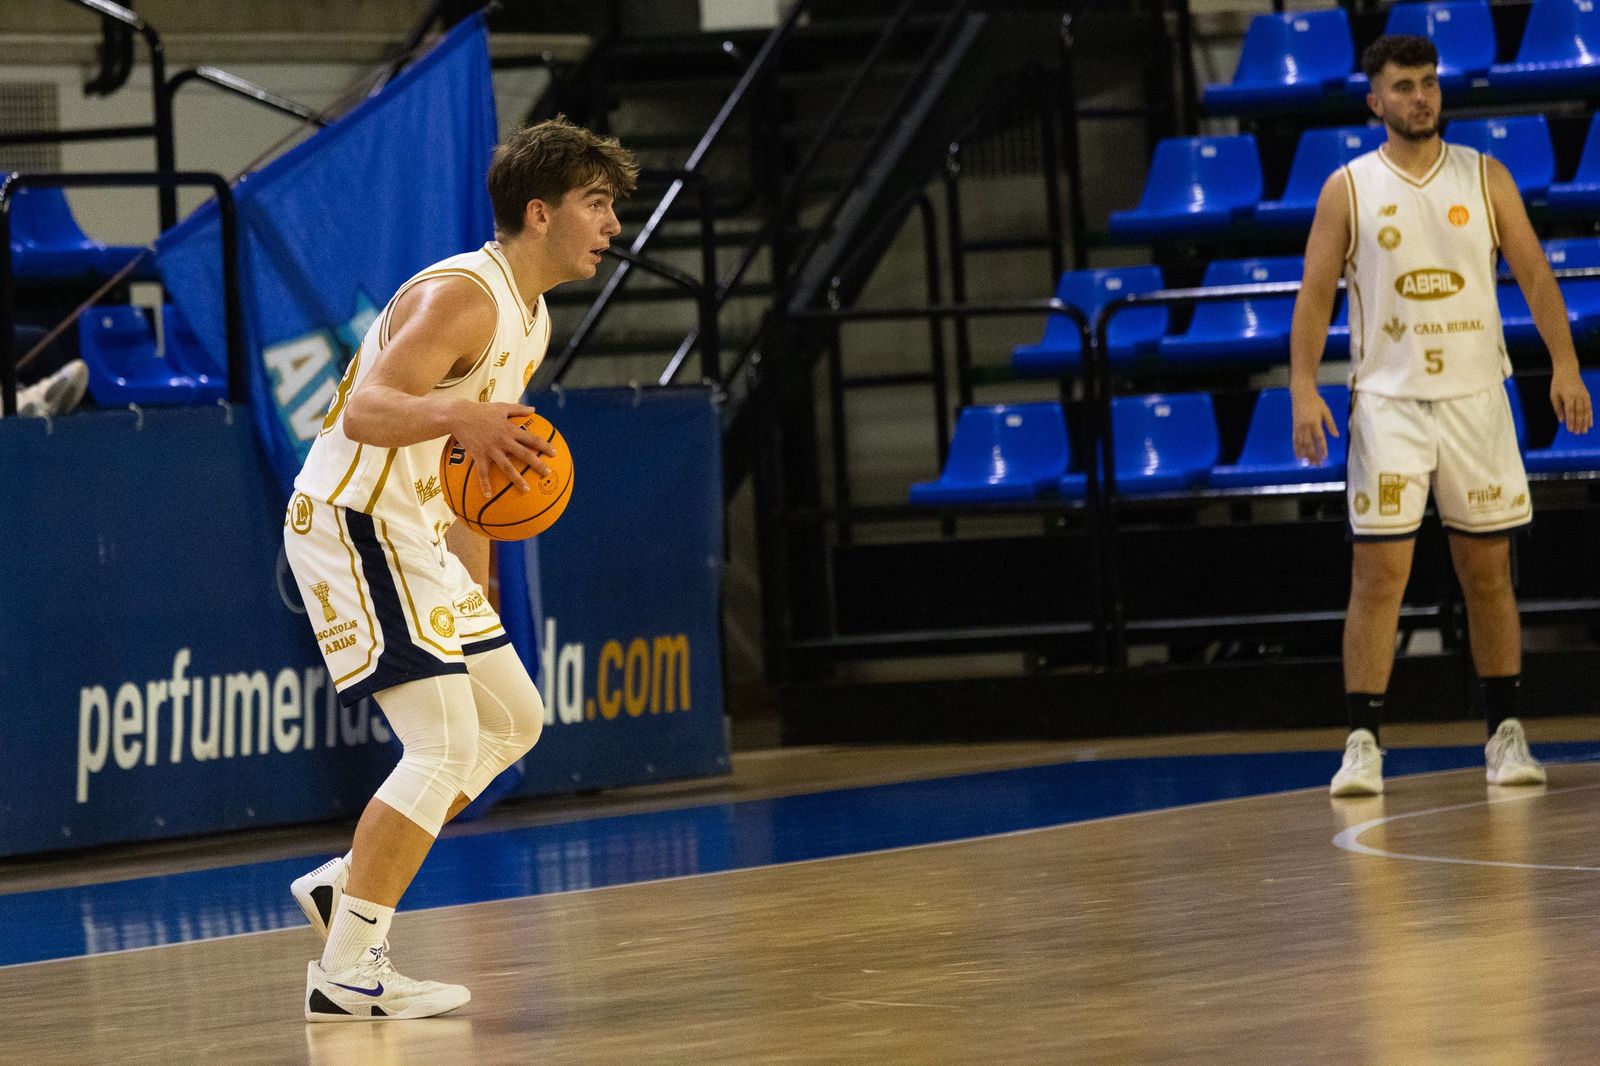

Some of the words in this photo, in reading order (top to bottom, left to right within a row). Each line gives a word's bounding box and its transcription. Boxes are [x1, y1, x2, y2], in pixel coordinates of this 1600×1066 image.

[1402, 273, 1459, 295] ABRIL
[1447, 319, 1484, 333] RURAL
[1424, 348, 1444, 375] 5
[325, 634, 357, 655] ARIAS
